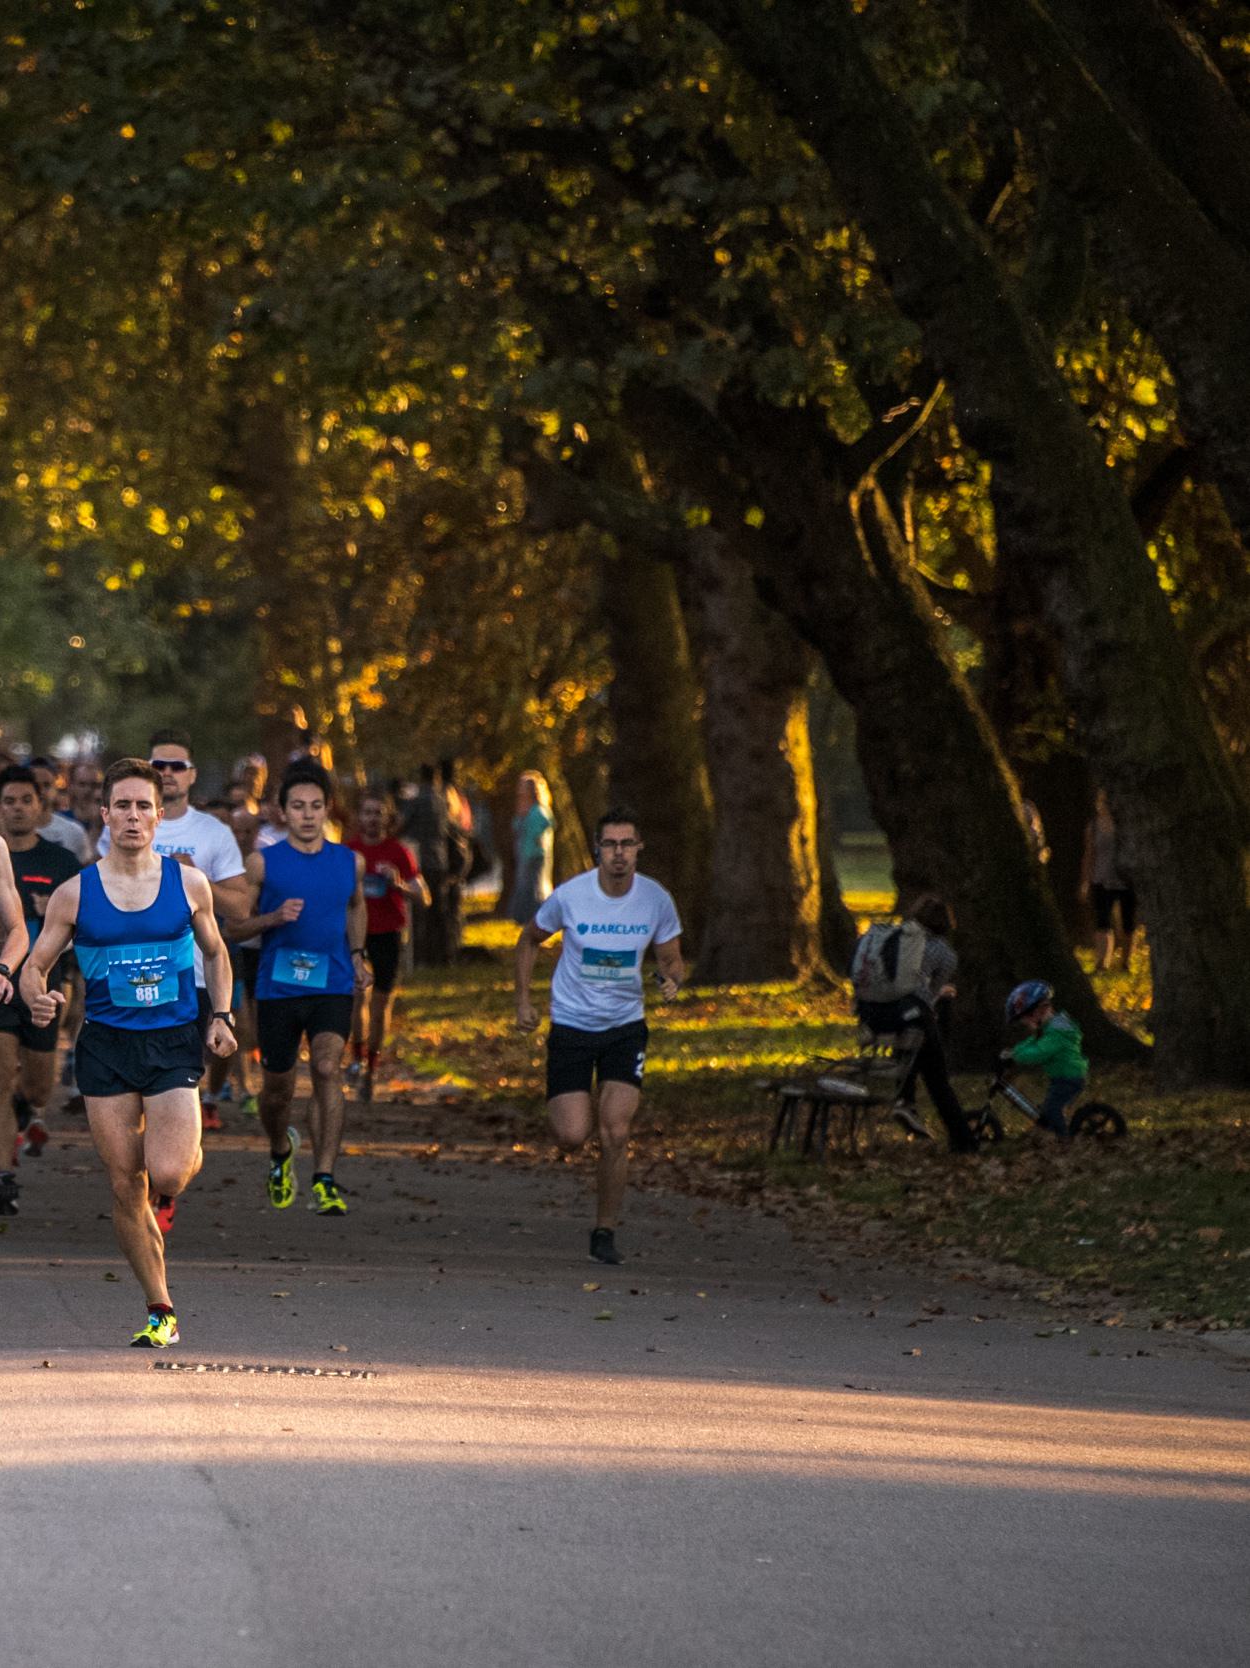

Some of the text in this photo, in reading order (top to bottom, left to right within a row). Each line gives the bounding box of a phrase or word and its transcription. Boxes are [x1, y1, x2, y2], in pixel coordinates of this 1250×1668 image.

[153, 844, 196, 856] RCLAYS
[591, 924, 649, 935] BARCLAYS
[135, 986, 159, 1002] 881
